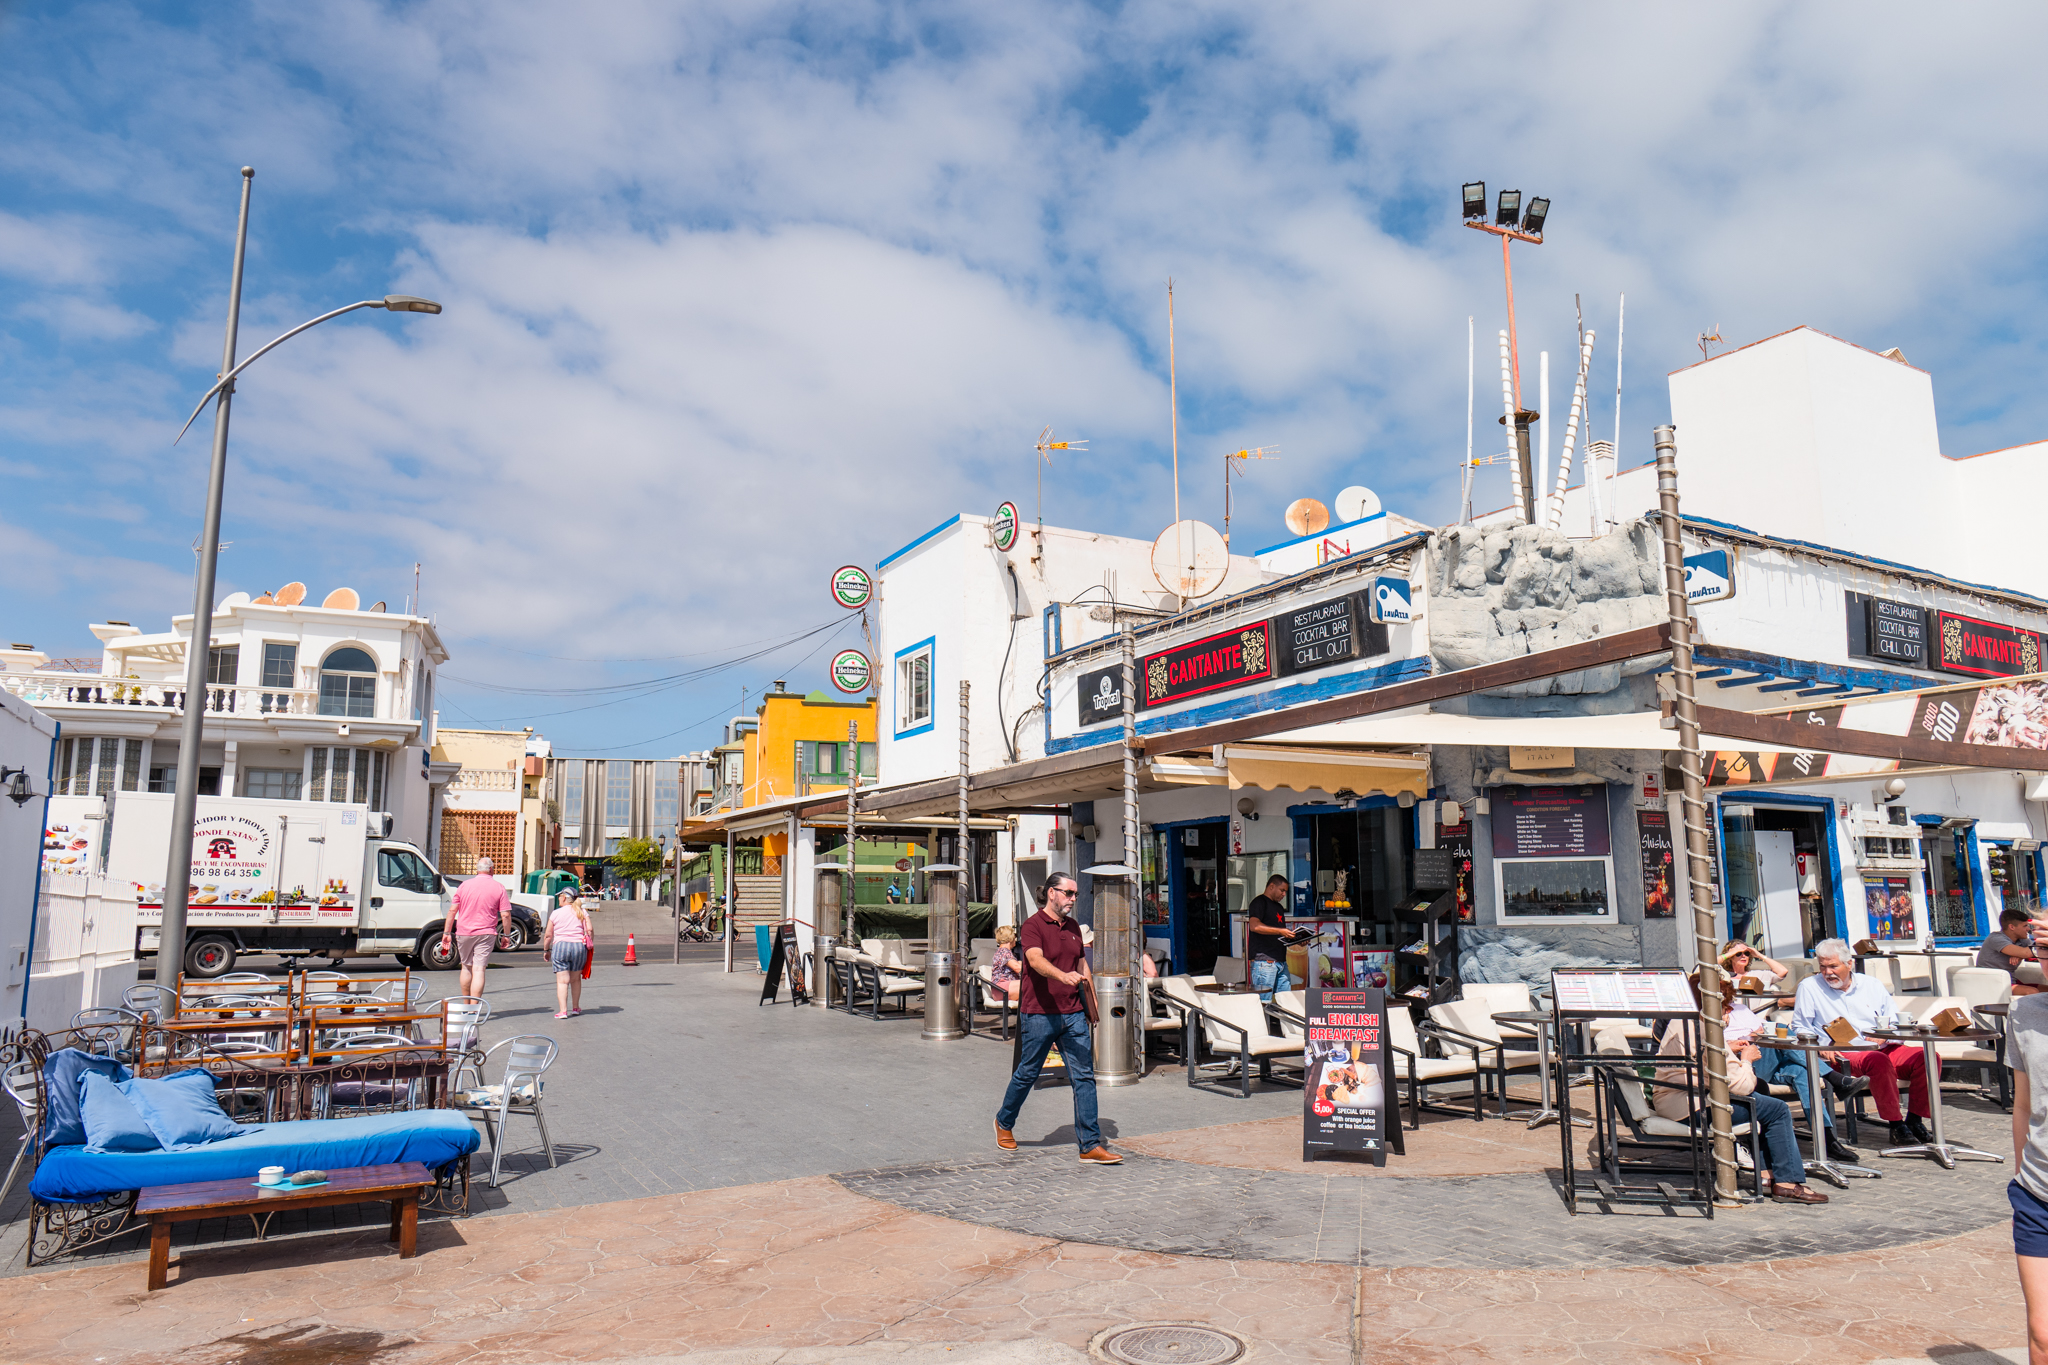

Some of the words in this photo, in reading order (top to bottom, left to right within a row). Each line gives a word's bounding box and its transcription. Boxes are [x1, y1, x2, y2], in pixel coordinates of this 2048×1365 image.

[838, 582, 868, 591] Heineken
[1688, 586, 1721, 598] LAVAZZA
[1294, 602, 1346, 626] RESTAURANT
[1384, 608, 1410, 620] LAVAZZA
[1878, 602, 1918, 620] RESTAURANT
[1294, 625, 1330, 645] COCKTAIL
[1332, 620, 1348, 636] BAR
[1879, 620, 1907, 637] COCKTAIL
[1908, 626, 1920, 639] BAR
[1296, 646, 1323, 664] CHILL
[1326, 638, 1348, 656] OUT
[1880, 639, 1902, 656] CHILL
[1904, 643, 1921, 658] OUT
[1963, 631, 2023, 666] CANTANTE
[838, 666, 868, 675] Heineken
[1169, 644, 1242, 686] CANTANTE
[1092, 688, 1120, 710] Tropical
[1922, 702, 1938, 732] GOOD
[1930, 700, 1960, 742] OOD
[226, 830, 258, 842] ESTAS?
[238, 817, 270, 856] PROVEEDOR
[1642, 834, 1671, 849] Shisha
[208, 868, 220, 877] 98
[224, 868, 236, 877] 64
[240, 869, 252, 878] 35
[1309, 1017, 1327, 1026] FULL
[1328, 1013, 1379, 1026] ENGLISH
[1309, 1028, 1380, 1042] BREAKFAST
[1314, 1102, 1333, 1113] 5,00€
